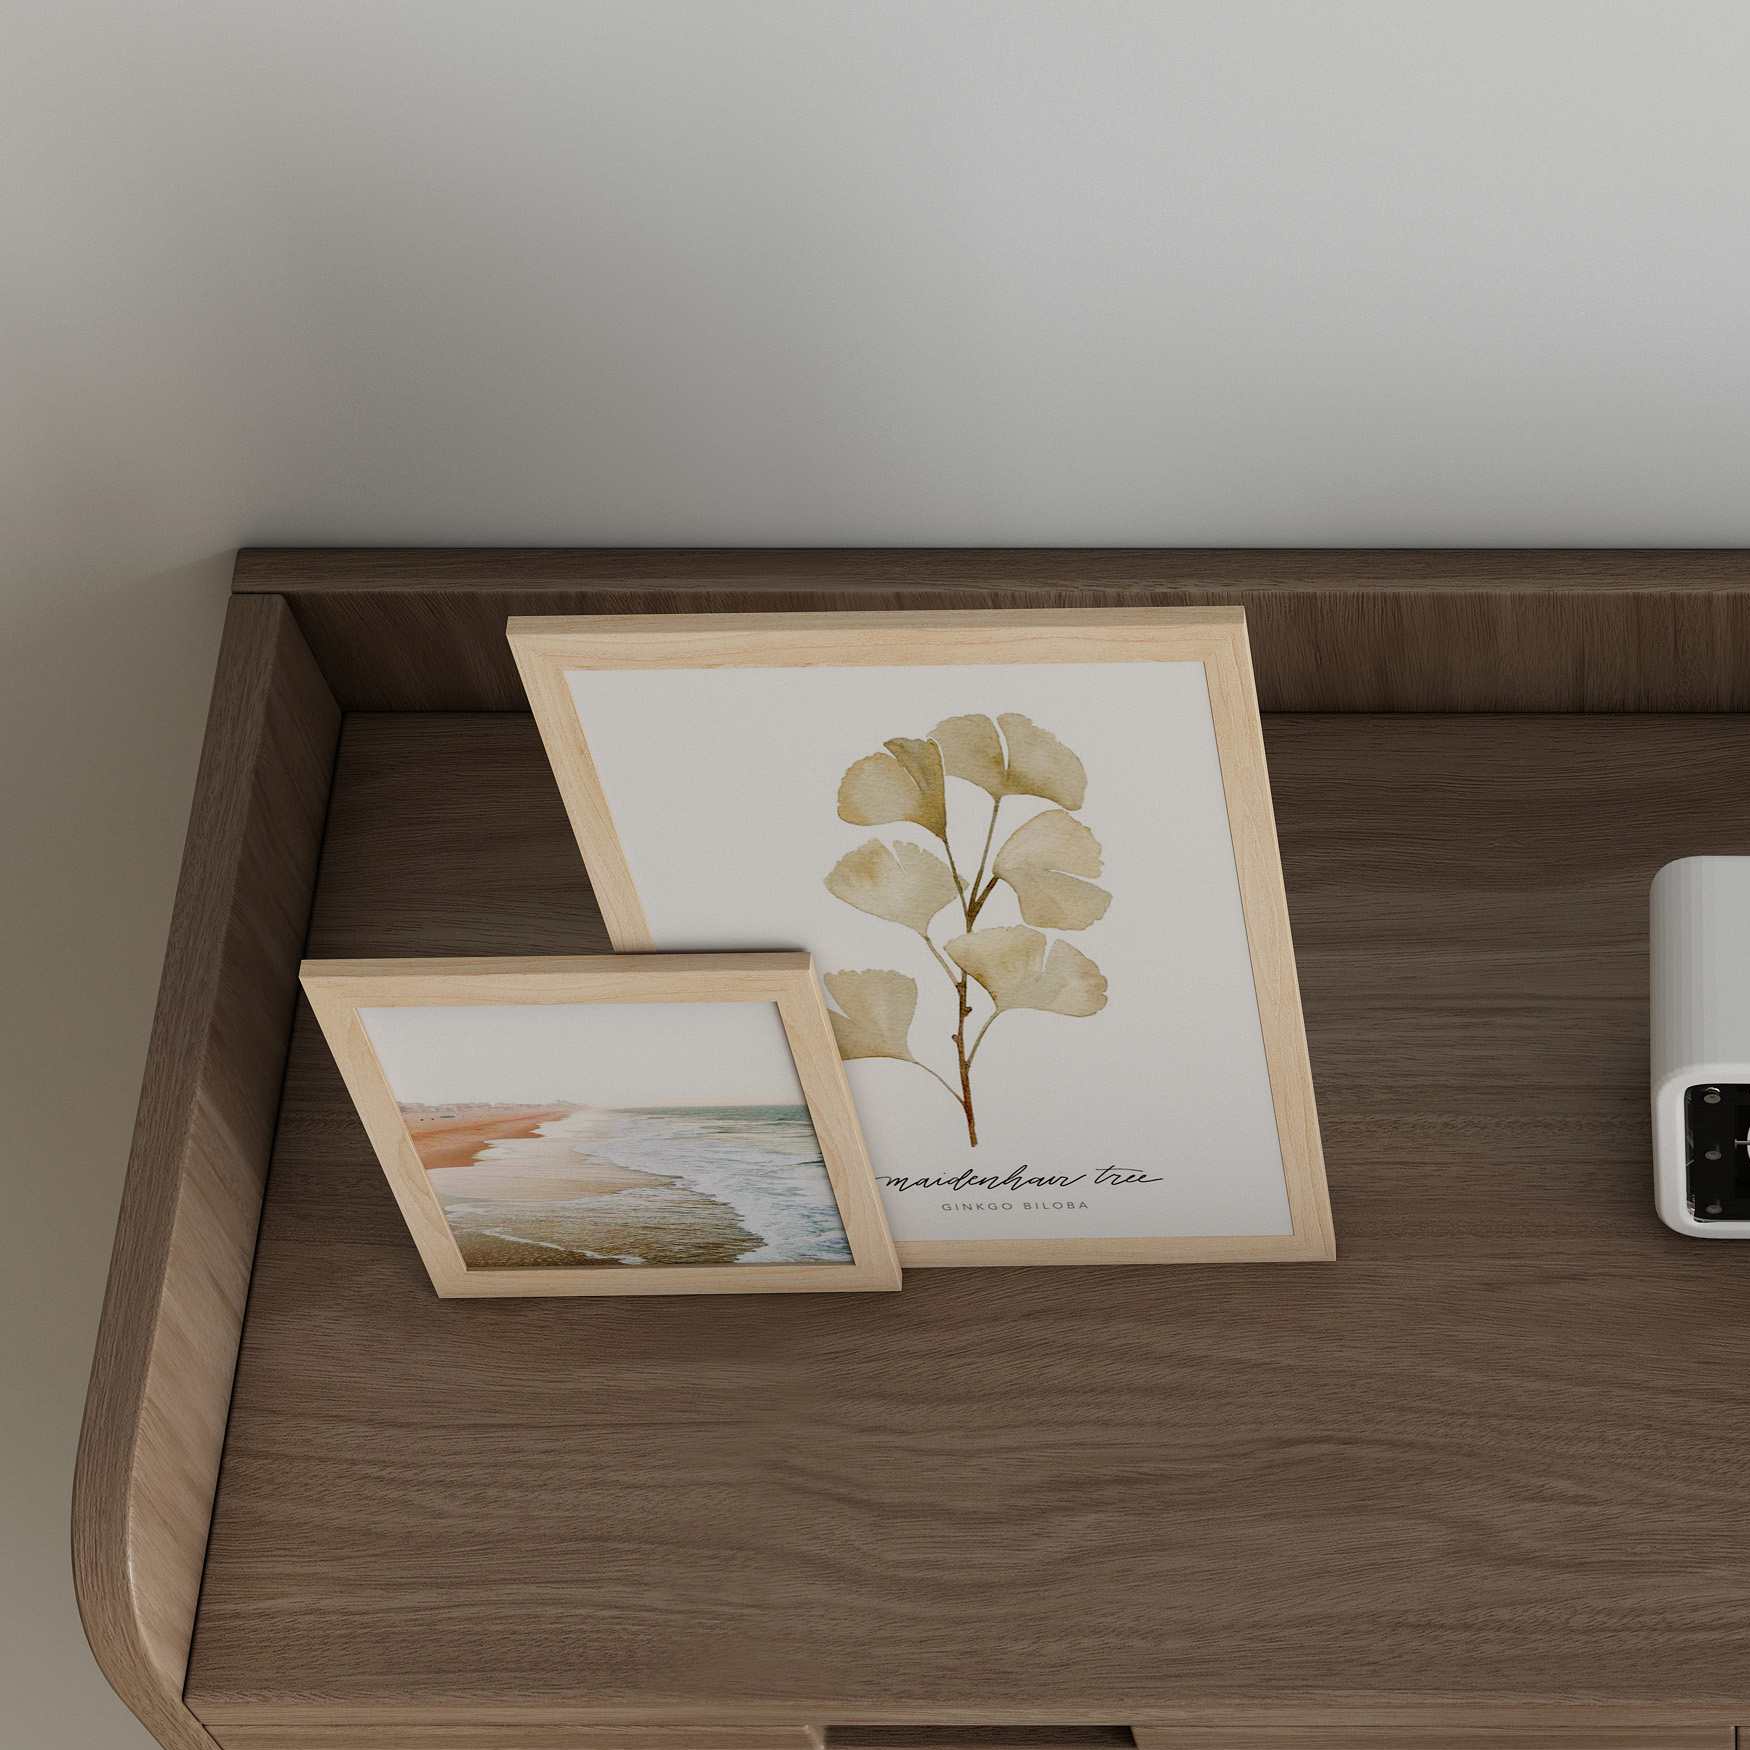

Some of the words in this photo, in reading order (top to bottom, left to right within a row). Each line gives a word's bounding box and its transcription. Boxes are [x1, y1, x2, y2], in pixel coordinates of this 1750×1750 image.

[1094, 1164, 1164, 1185] tree
[941, 1202, 1013, 1211] GINKGO
[1023, 1201, 1088, 1210] BILOBA
